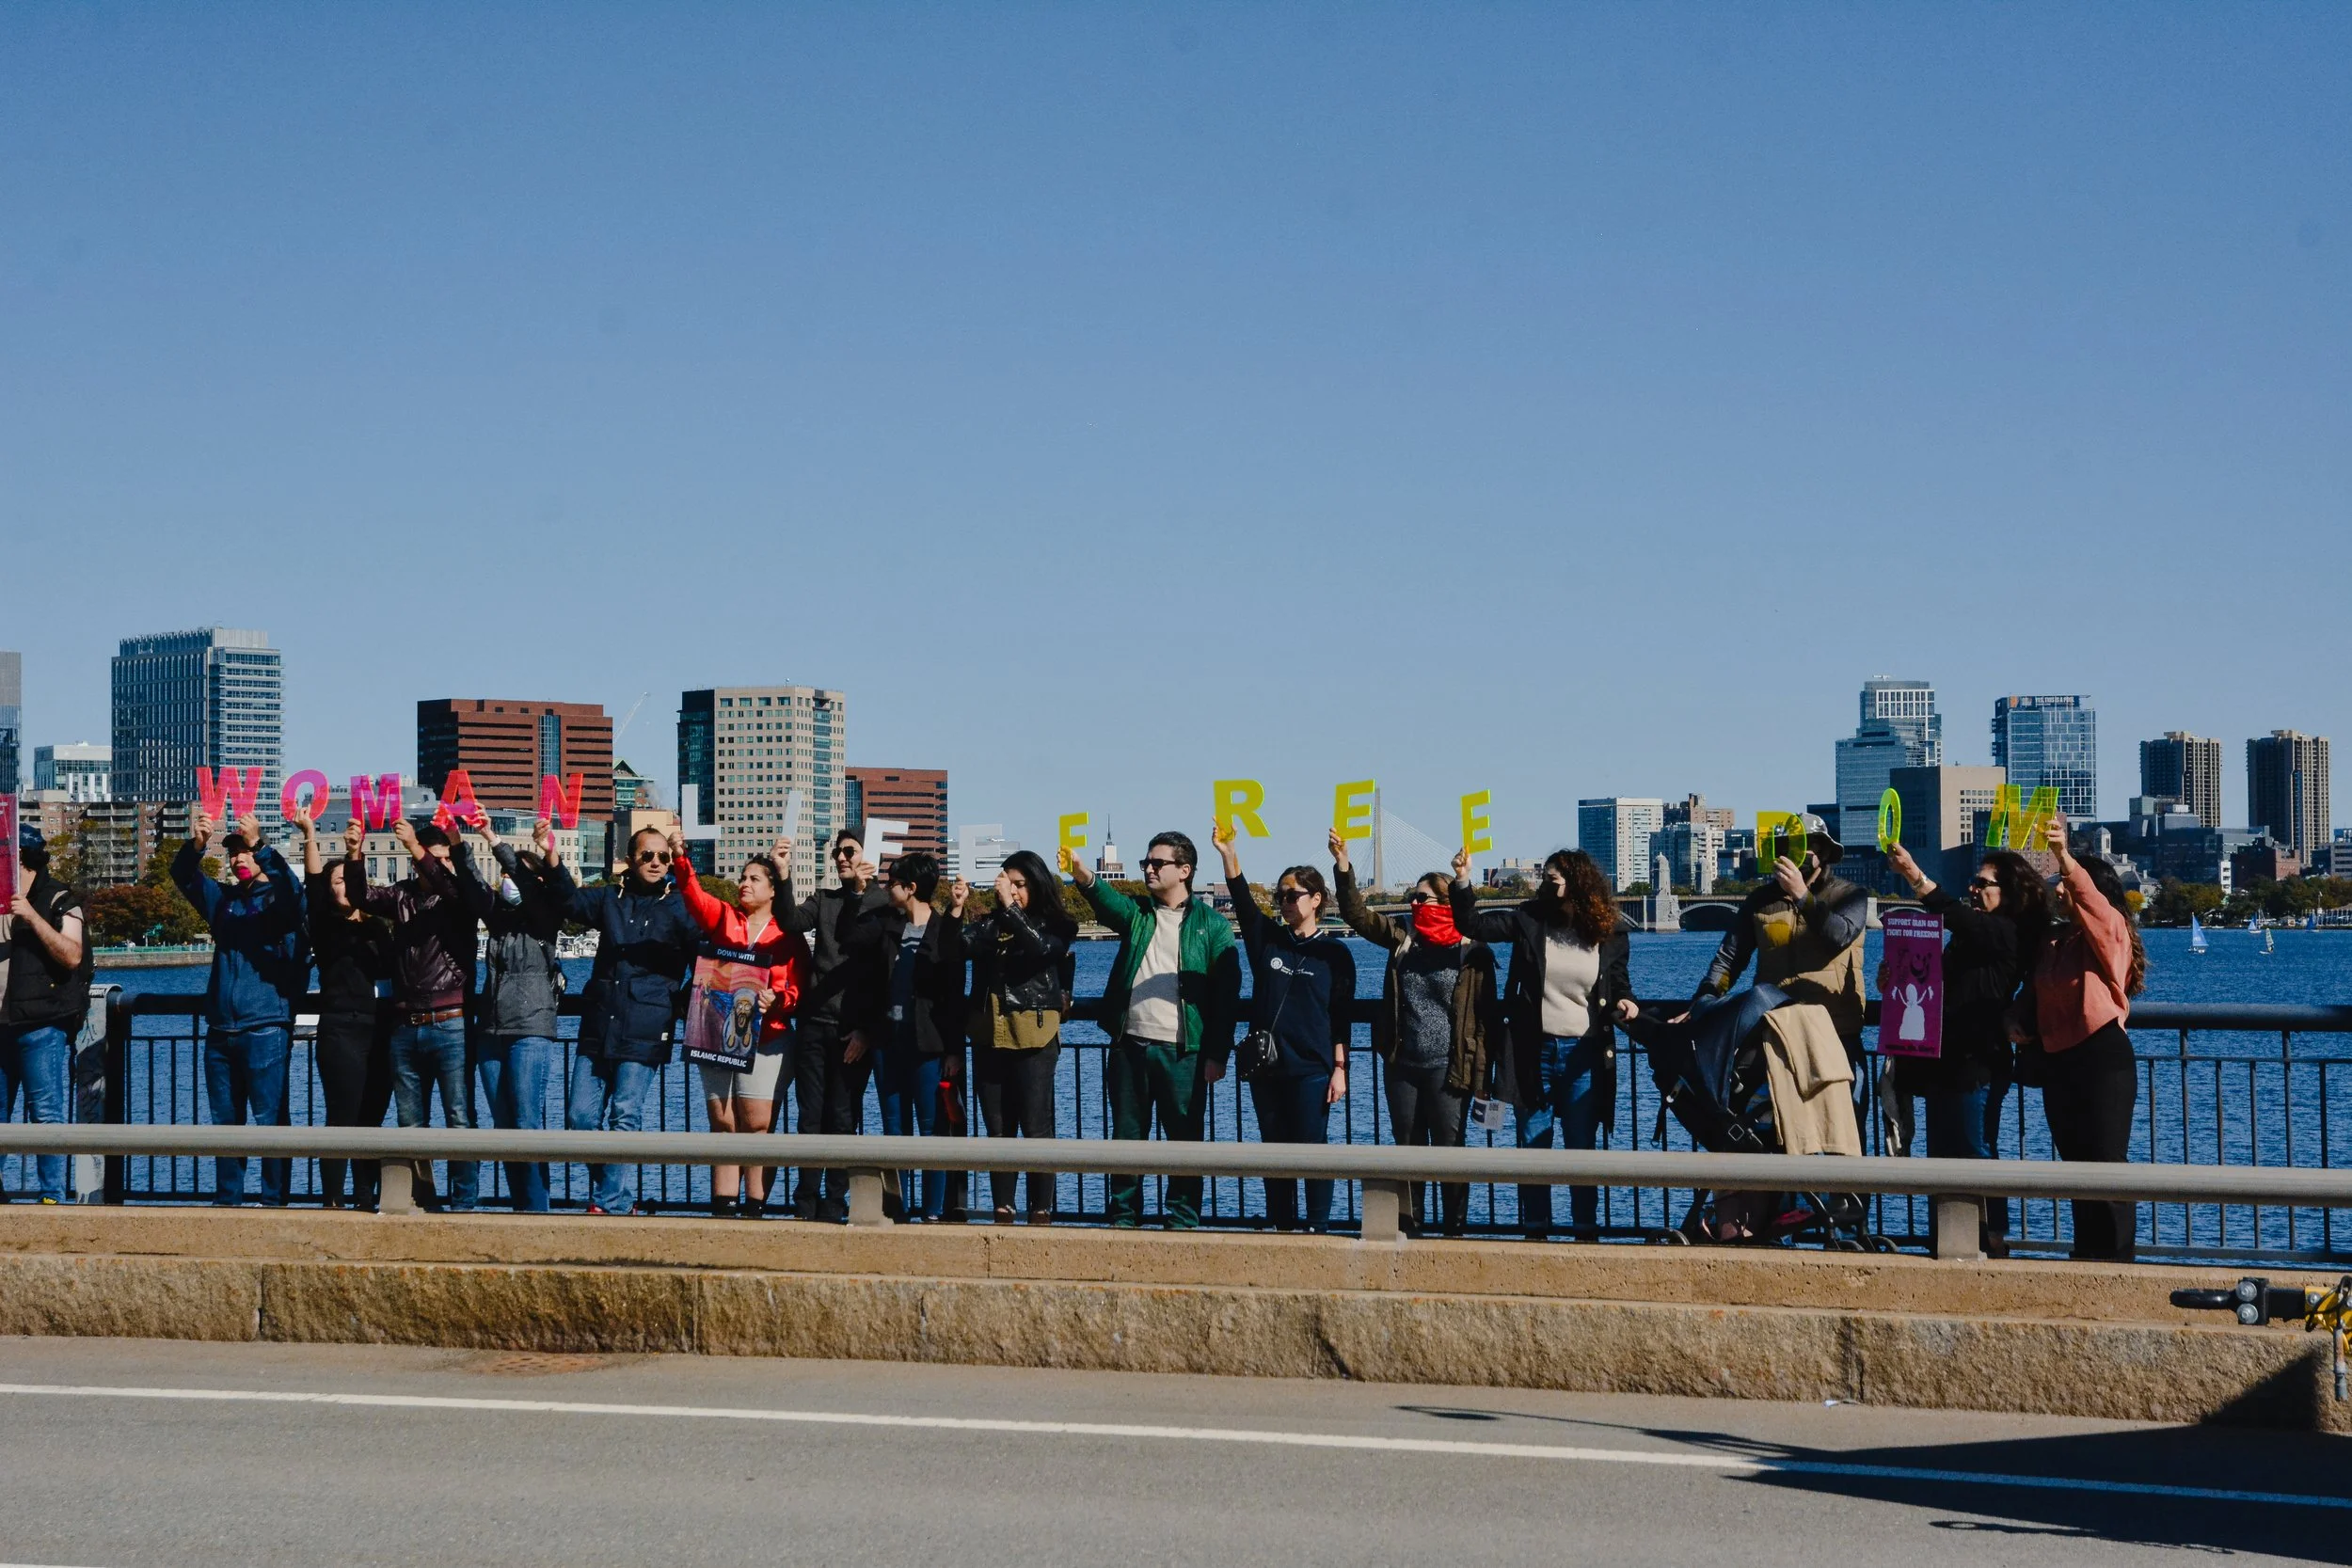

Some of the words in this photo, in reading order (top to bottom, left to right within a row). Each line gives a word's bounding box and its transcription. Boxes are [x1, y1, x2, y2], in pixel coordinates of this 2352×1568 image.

[196, 767, 584, 831] WOMAN
[1887, 917, 1911, 926] SUPPORT
[1927, 920, 1939, 928] AND
[1886, 928, 1902, 937] FIGHT
[1914, 929, 1940, 939] FREEDOM
[717, 948, 738, 958] DOWN
[738, 952, 755, 961] WITH
[690, 1049, 717, 1062] ISLAMIC
[717, 1054, 748, 1068] REPUBLIC
